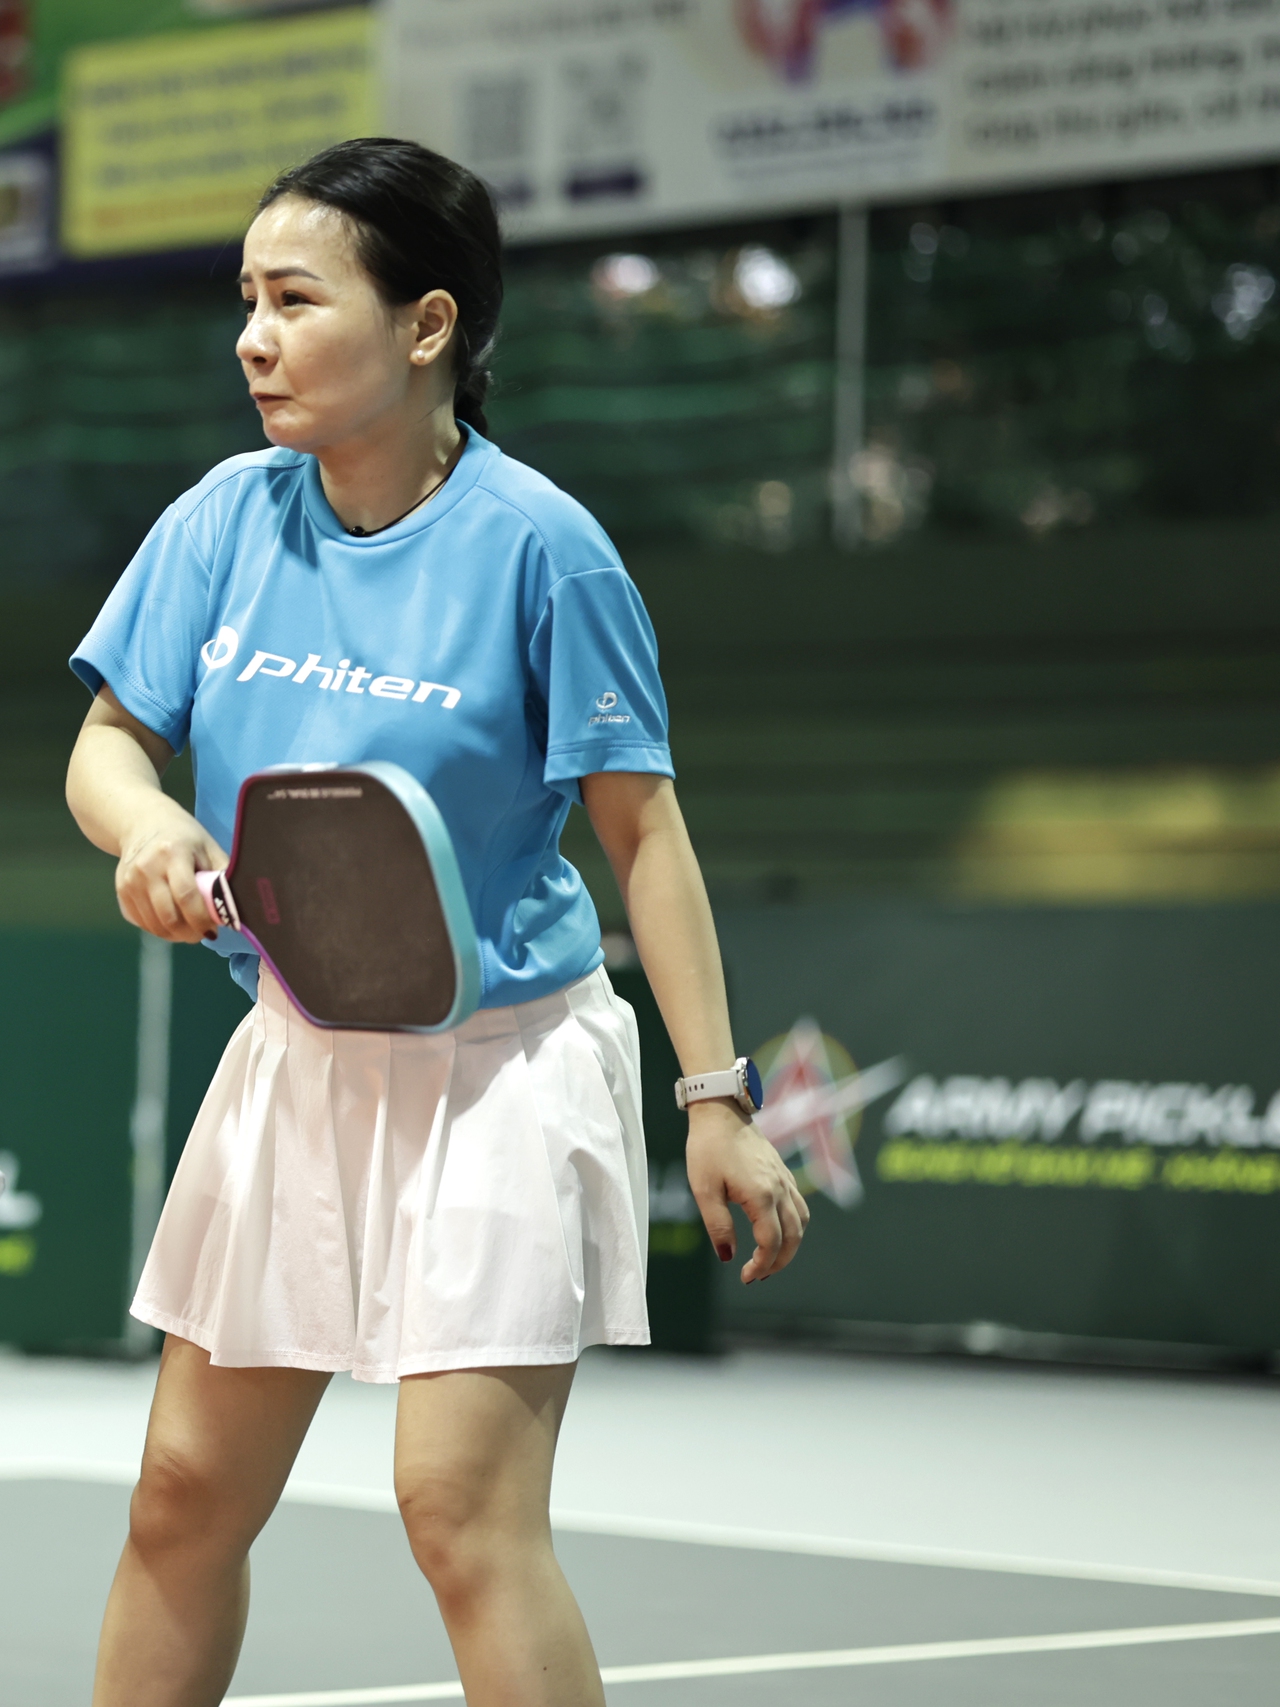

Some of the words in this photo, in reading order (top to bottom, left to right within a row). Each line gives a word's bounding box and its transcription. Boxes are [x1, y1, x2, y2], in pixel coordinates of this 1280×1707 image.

[236, 649, 463, 709] phiten
[588, 712, 631, 727] phiten
[884, 1074, 1086, 1142] ARMY
